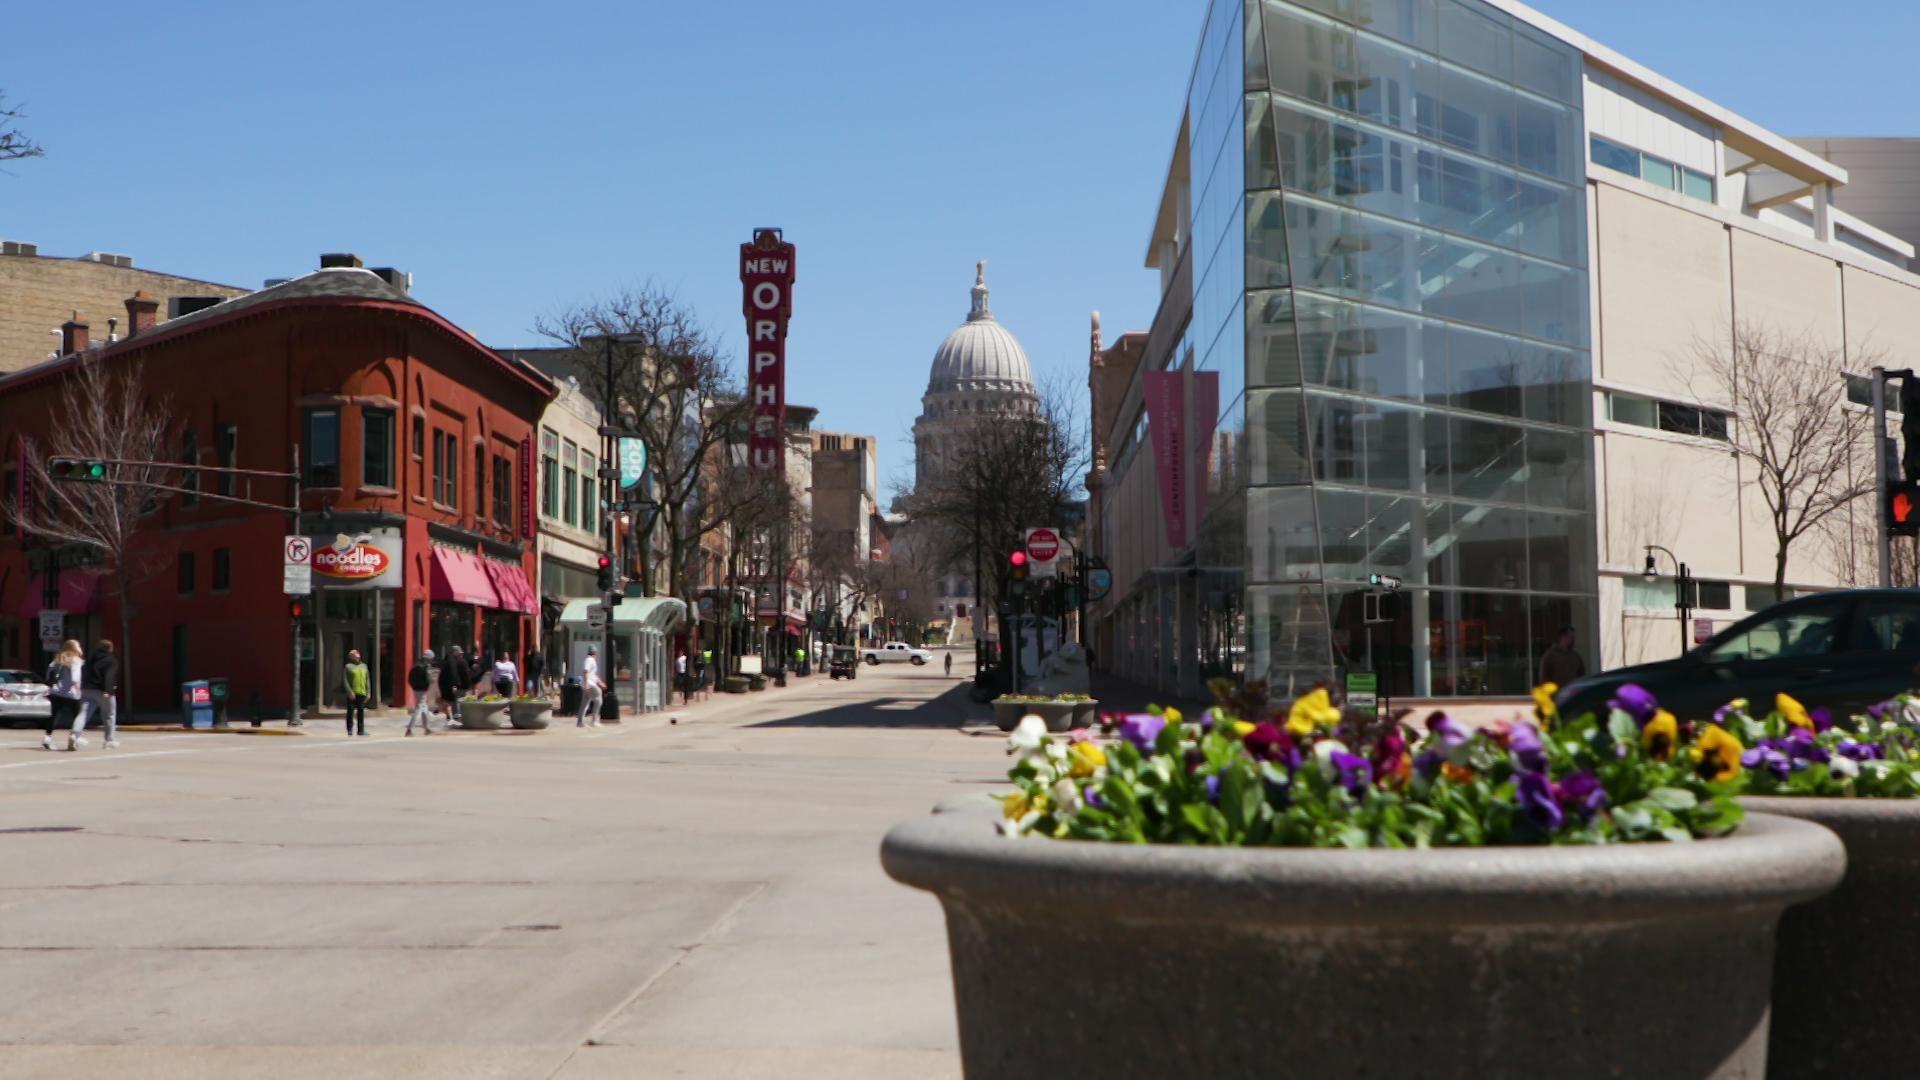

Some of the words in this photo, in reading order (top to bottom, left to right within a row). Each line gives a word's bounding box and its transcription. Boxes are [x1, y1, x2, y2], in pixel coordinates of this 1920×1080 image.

[745, 258, 788, 274] NEW
[752, 282, 780, 470] ORPHEU
[316, 546, 381, 566] noodles
[42, 624, 61, 636] 25
